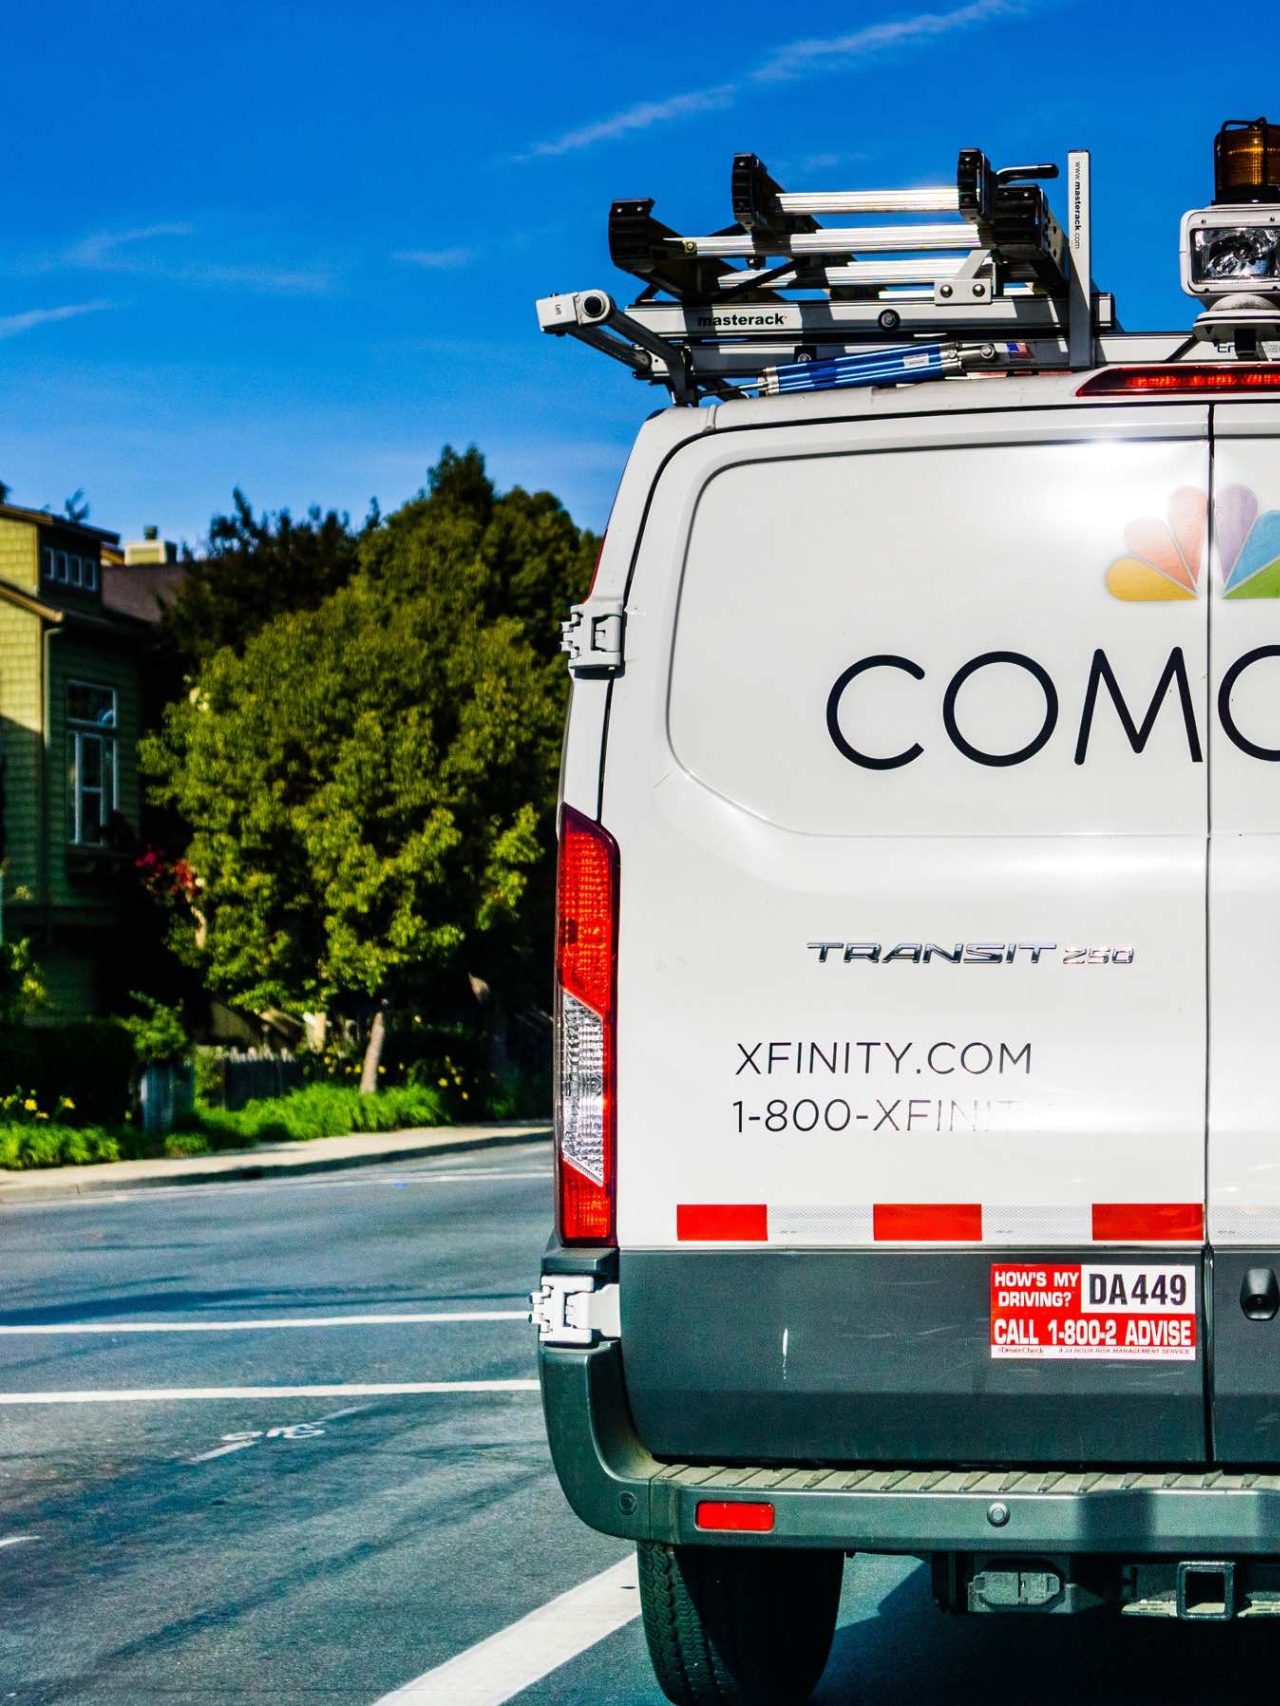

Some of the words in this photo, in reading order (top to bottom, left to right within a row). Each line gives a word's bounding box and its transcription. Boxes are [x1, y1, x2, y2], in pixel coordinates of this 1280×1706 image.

[806, 942, 1057, 964] TRANSIT
[1062, 945, 1135, 965] 250
[735, 1042, 1033, 1075] XFINITY.COM
[994, 1271, 1047, 1288] HOW'S
[1053, 1272, 1080, 1288] MY
[1088, 1273, 1188, 1306] DA449
[998, 1291, 1072, 1308] DRIVING?
[994, 1318, 1040, 1345] CALL
[1047, 1319, 1117, 1346] 1-800-2
[1124, 1319, 1192, 1346] ADVISE
